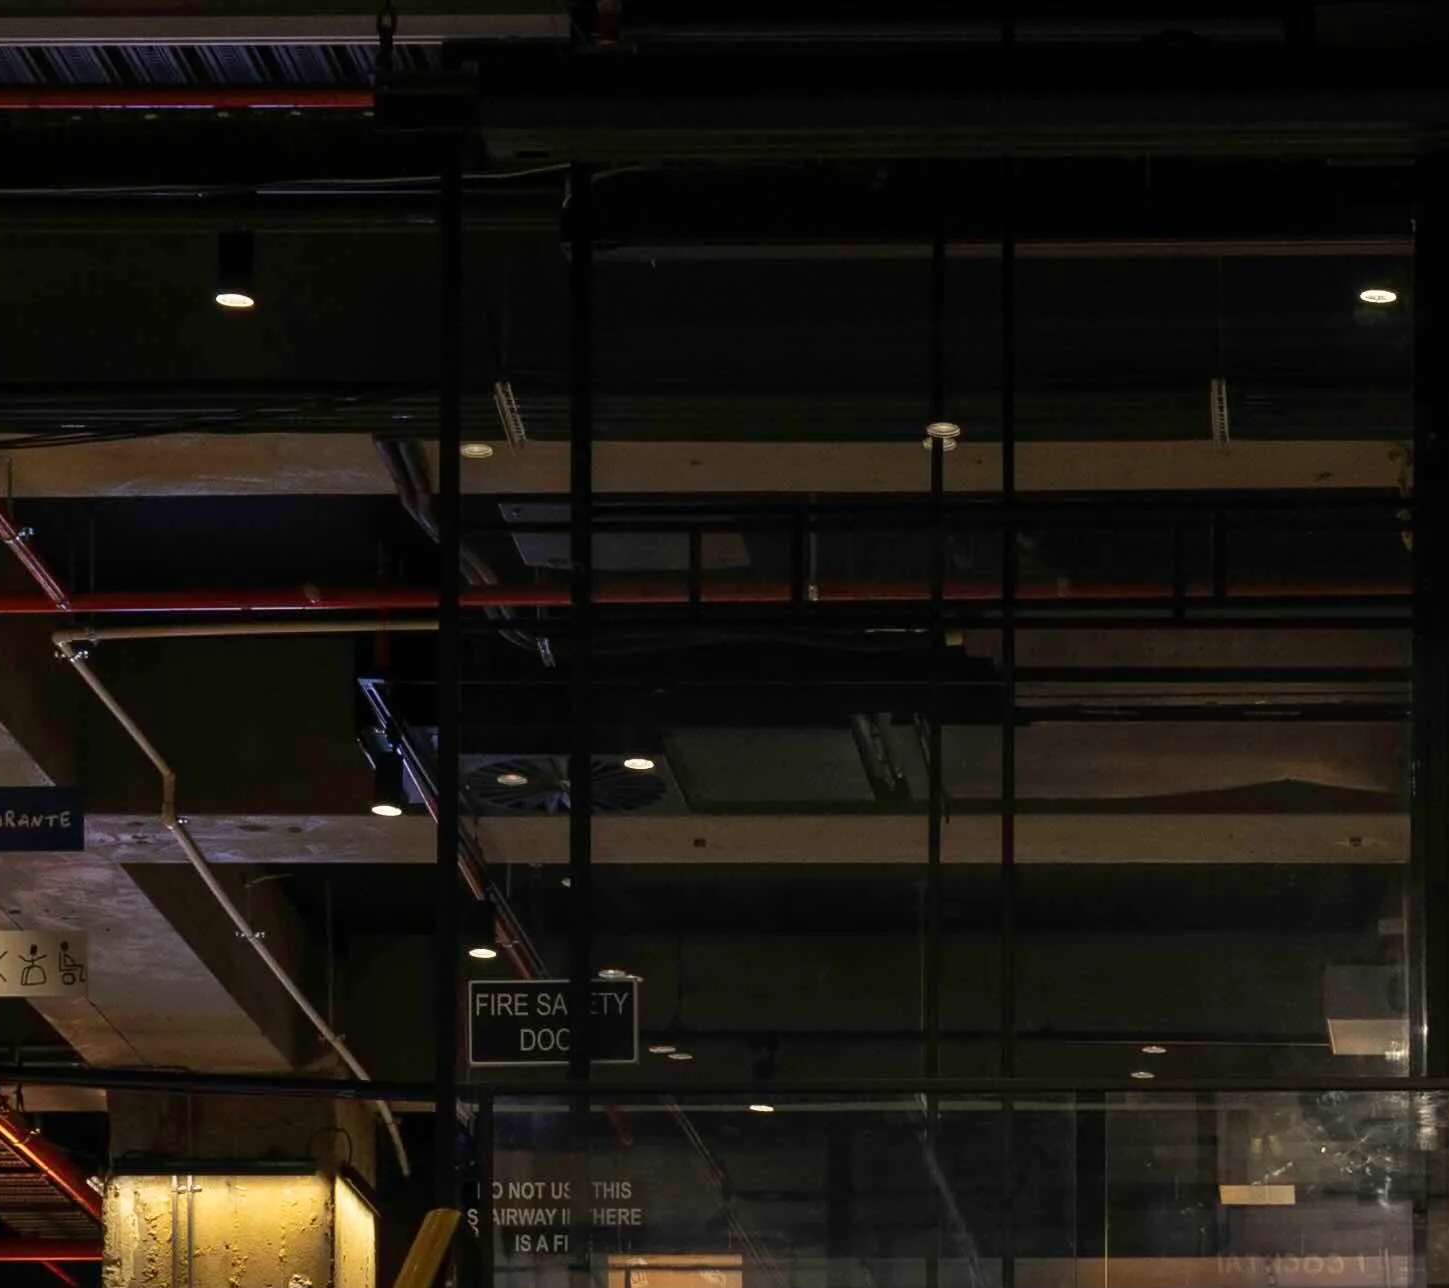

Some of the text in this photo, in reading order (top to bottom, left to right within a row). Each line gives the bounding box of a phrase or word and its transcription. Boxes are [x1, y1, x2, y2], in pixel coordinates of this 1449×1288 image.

[475, 992, 630, 1017] FIRE SAETY
[520, 1028, 571, 1052] DOO
[508, 1181, 546, 1201] NOT
[592, 1181, 632, 1201] THIS
[466, 1208, 557, 1228] SAIRWAY
[589, 1208, 642, 1227] HERE
[515, 1234, 533, 1253] IS
[536, 1234, 550, 1253] A
